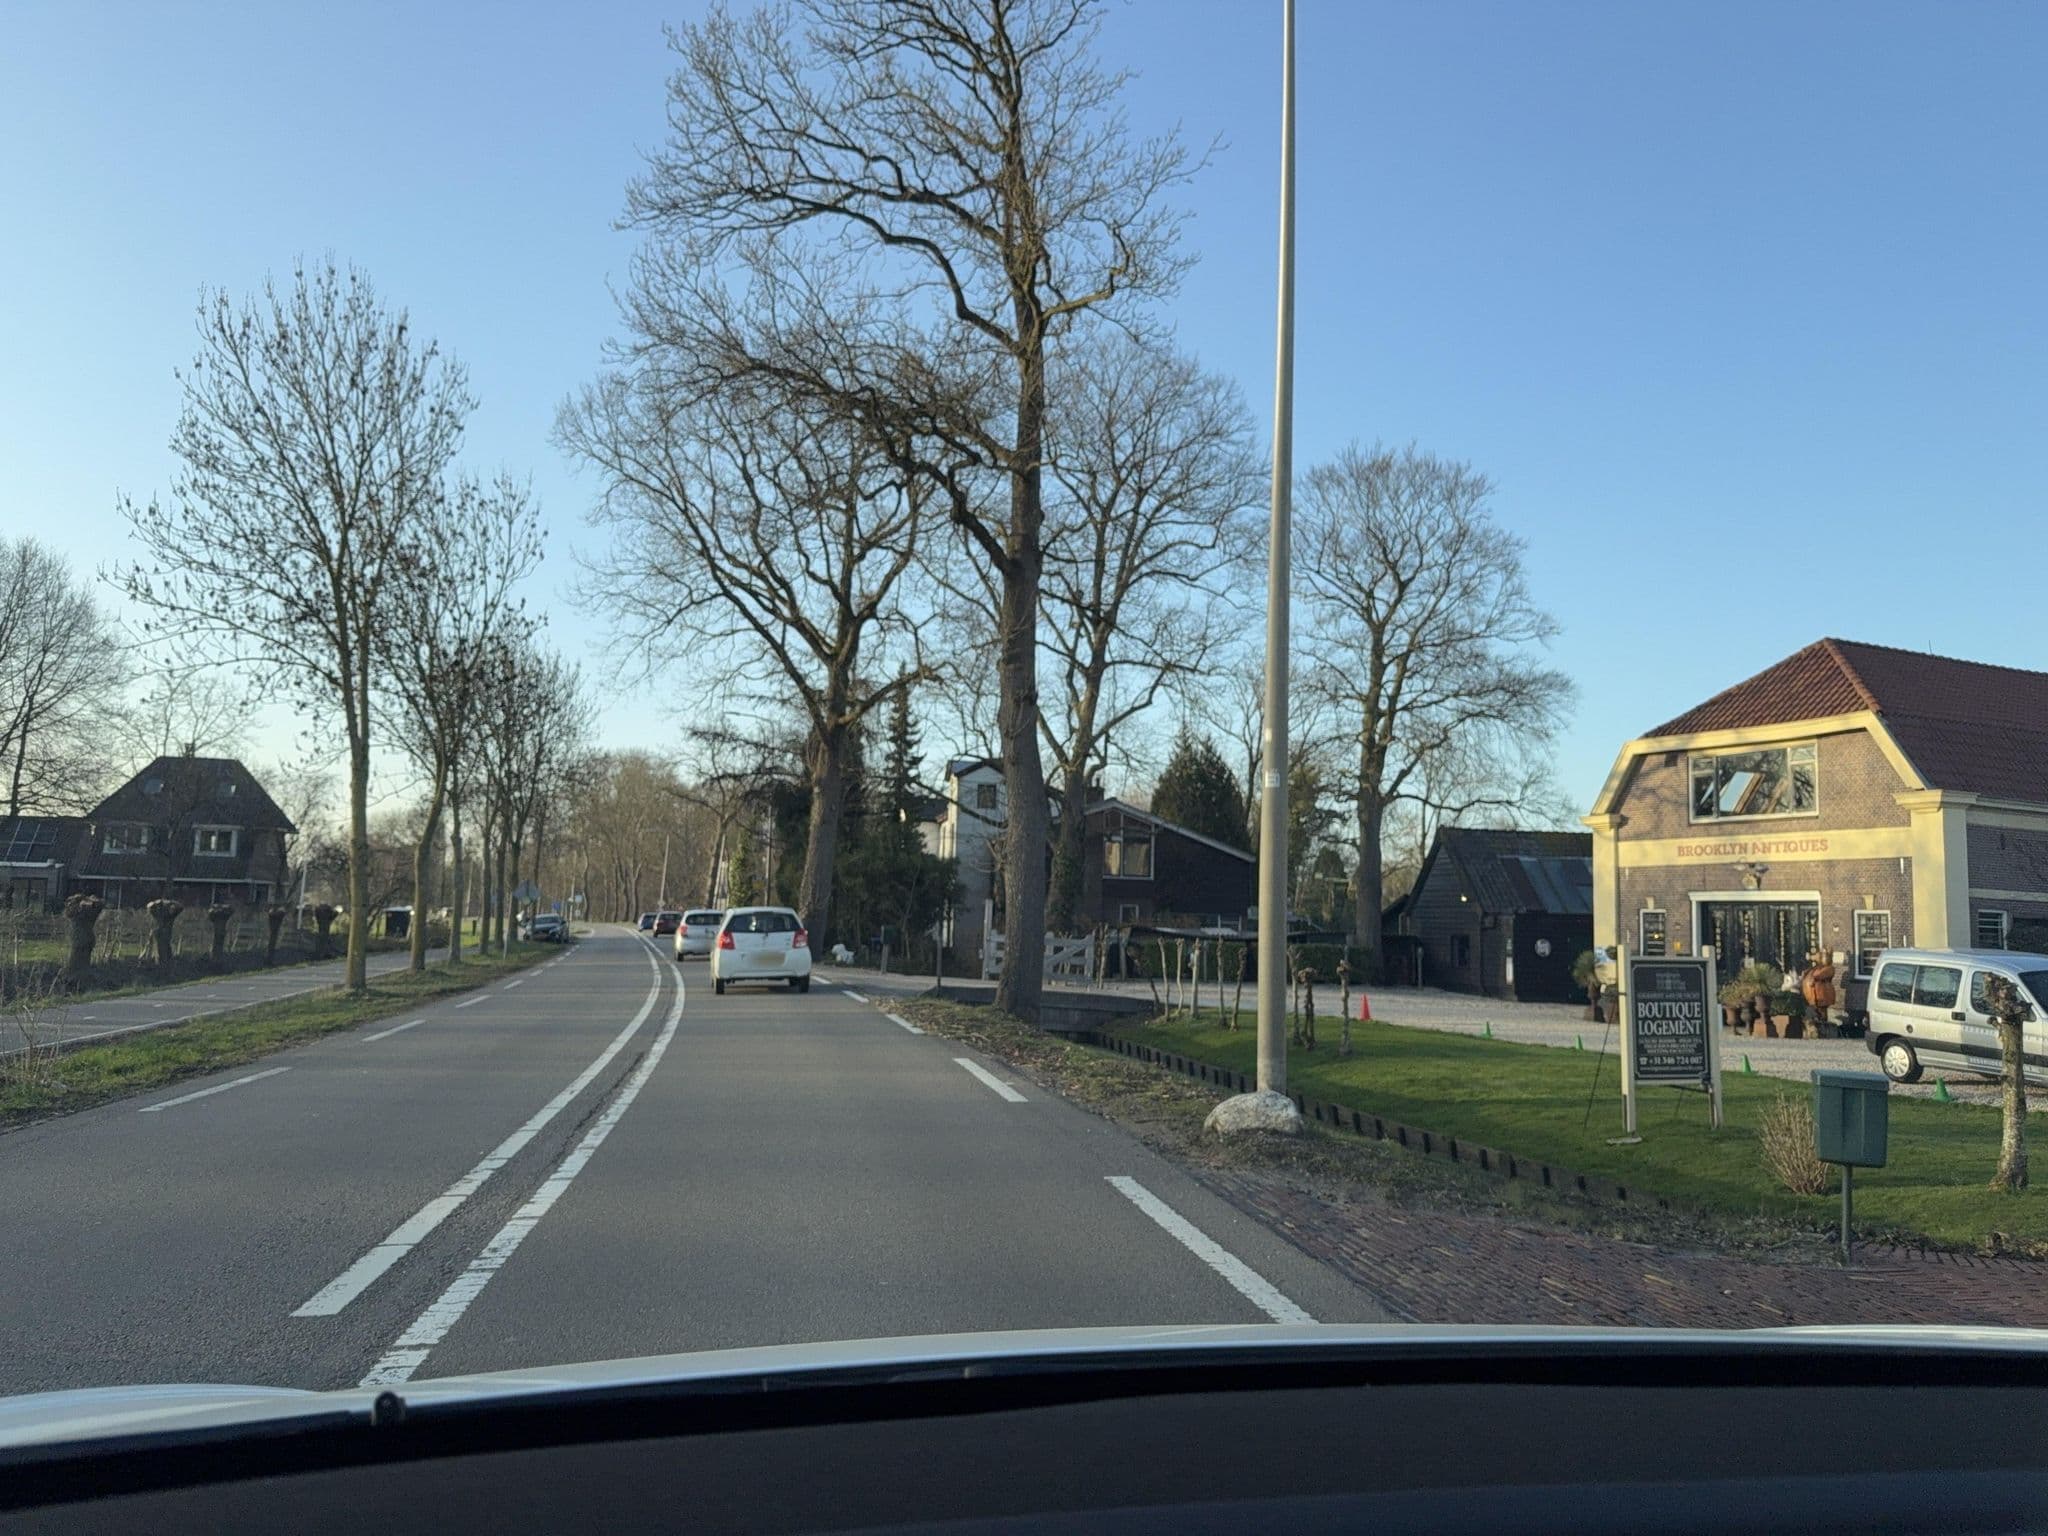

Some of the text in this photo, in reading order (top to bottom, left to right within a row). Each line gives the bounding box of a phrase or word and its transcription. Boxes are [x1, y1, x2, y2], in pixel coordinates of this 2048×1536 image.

[1677, 839, 1829, 857] BROOKLYN ANTIQUES
[1637, 1001, 1702, 1021] BOUTIQUE
[1638, 1020, 1702, 1035] LOGEMENT
[1676, 1056, 1689, 1065] 724
